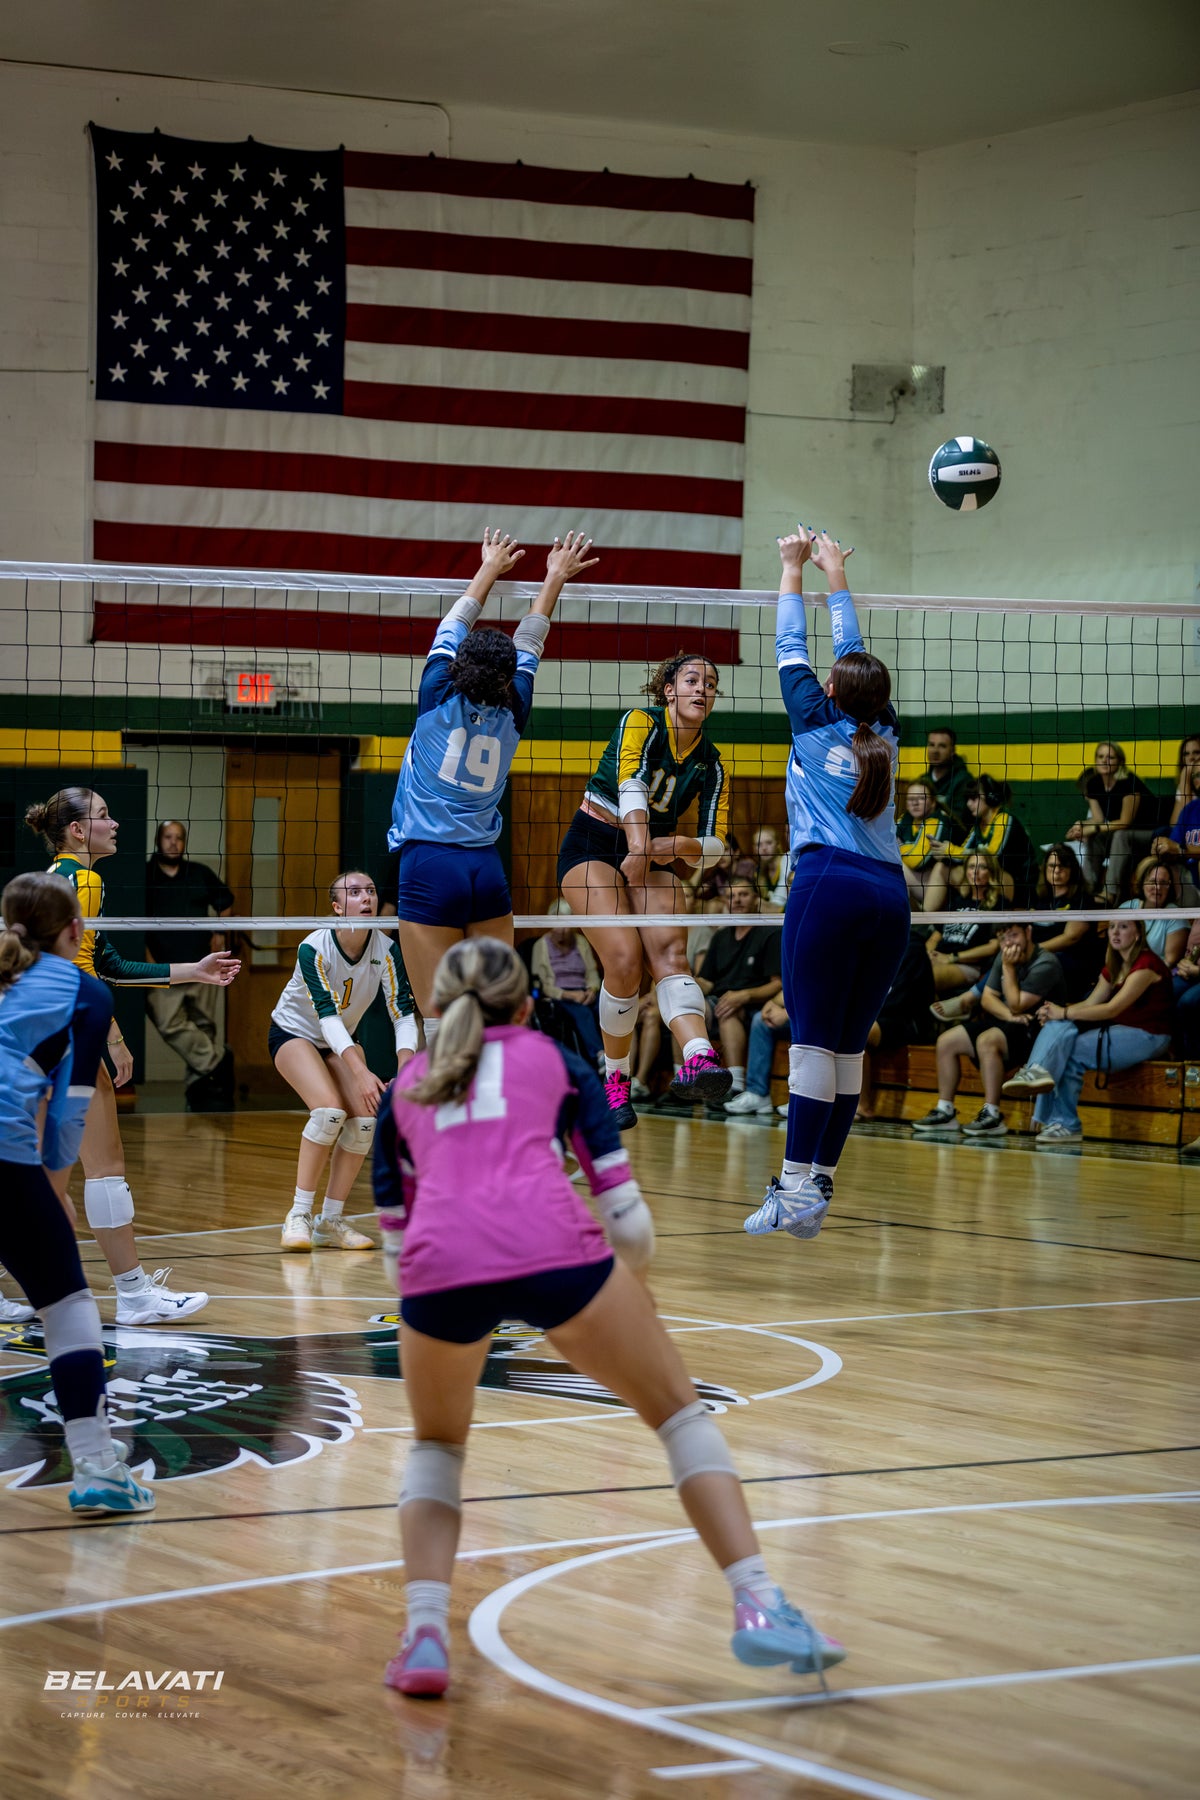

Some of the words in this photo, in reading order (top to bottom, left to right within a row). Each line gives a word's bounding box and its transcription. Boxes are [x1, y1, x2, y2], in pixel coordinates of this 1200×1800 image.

[237, 673, 272, 703] EXIT
[438, 726, 501, 793] 19
[648, 767, 677, 813] 11
[341, 977, 354, 1010] 1
